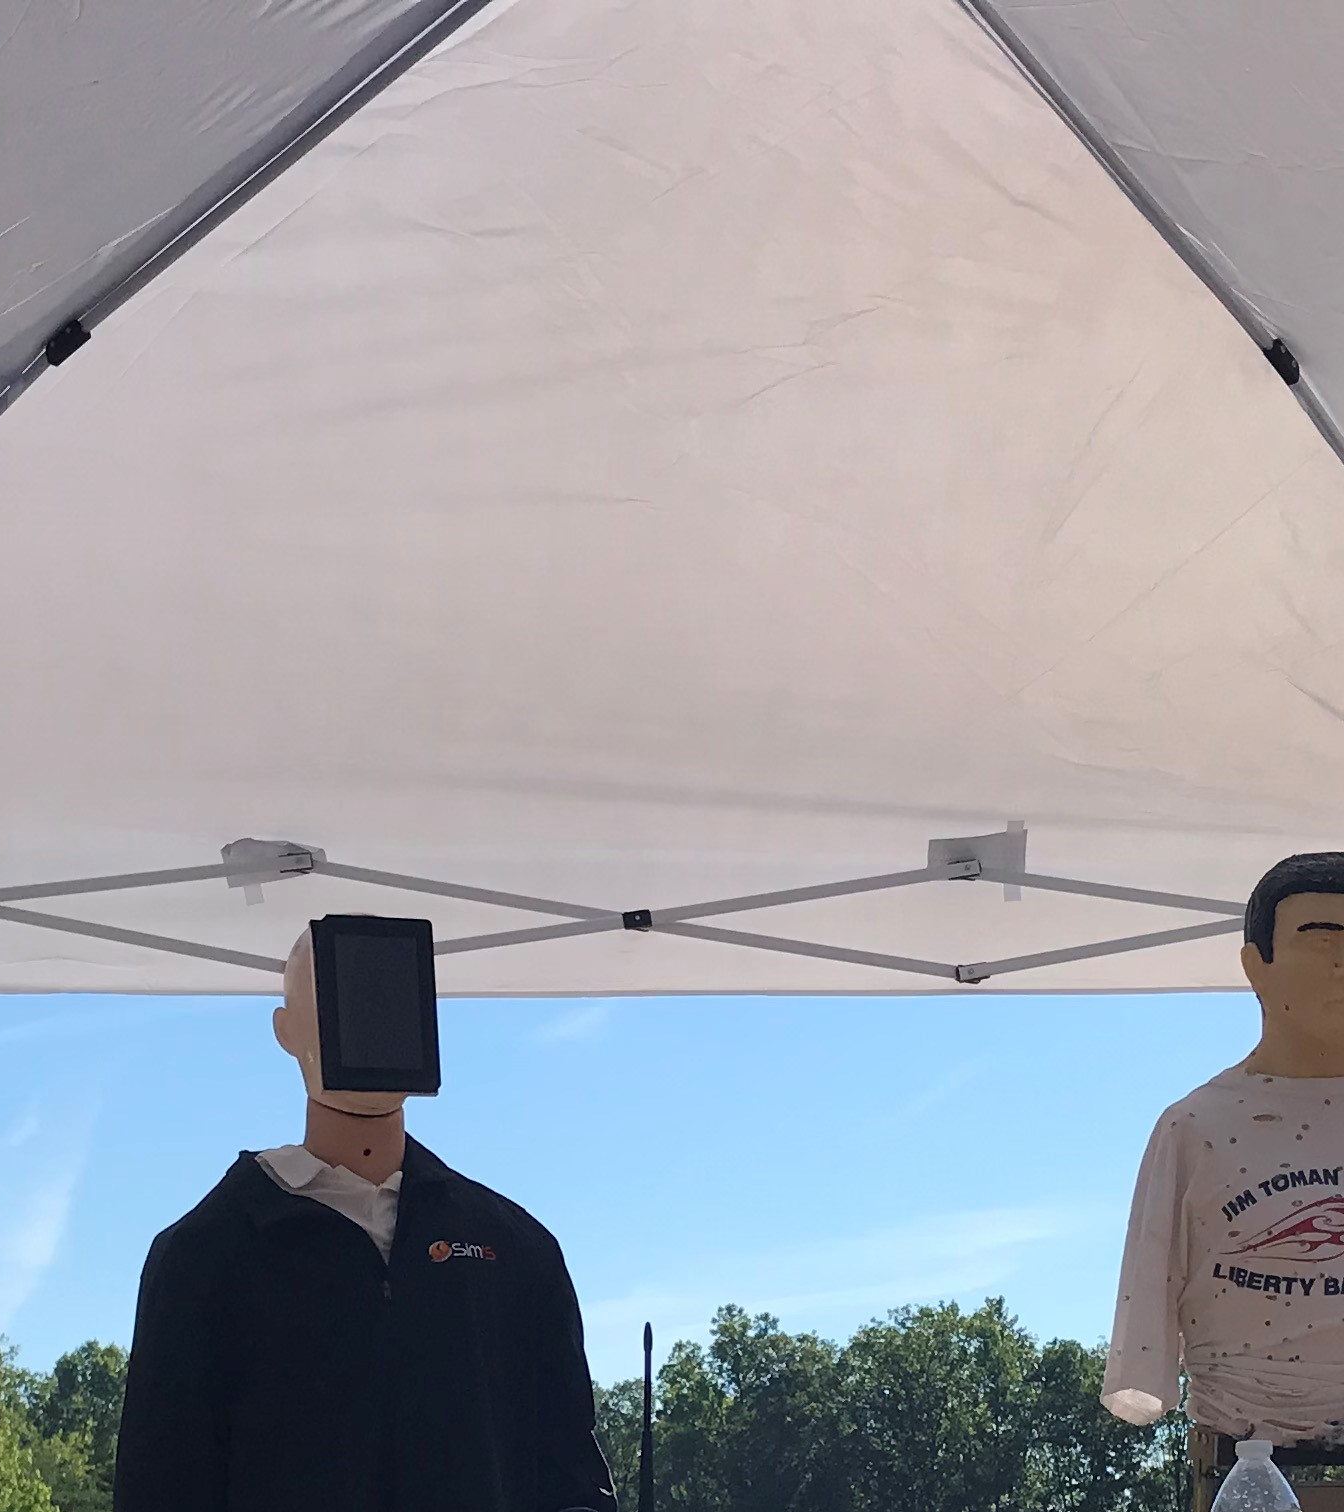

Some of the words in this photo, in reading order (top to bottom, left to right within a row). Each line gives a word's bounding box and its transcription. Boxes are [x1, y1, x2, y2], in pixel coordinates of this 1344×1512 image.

[1220, 1189, 1258, 1223] JIM
[1258, 1167, 1340, 1199] TOMAN
[1212, 1262, 1316, 1297] LIBERTY
